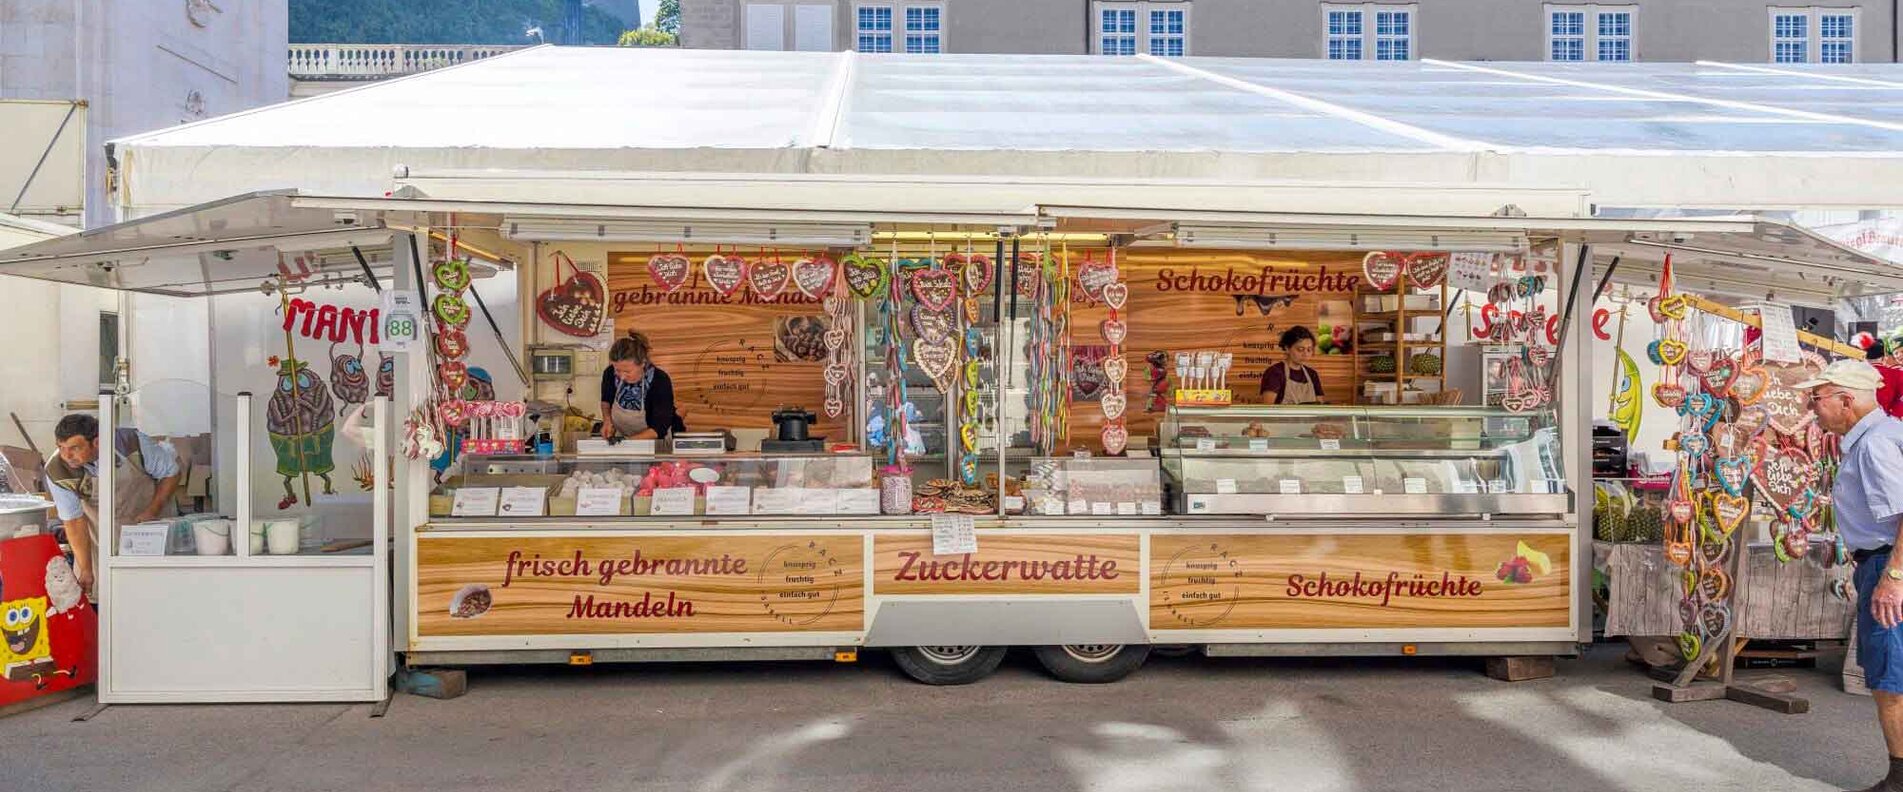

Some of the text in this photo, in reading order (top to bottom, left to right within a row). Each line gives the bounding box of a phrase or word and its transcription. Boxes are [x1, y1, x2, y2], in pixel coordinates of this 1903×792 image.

[1156, 266, 1360, 296] Schokofrüchte
[614, 284, 732, 313] gebrannte
[389, 320, 412, 336] 88
[1767, 401, 1799, 416] Dich
[502, 549, 748, 588] frisch gebrannte
[894, 551, 1120, 582] Zuckerwatte
[785, 575, 815, 584] fruchtig
[1187, 576, 1216, 585] fruchtig
[1286, 571, 1483, 607] Schokofrüchte
[566, 591, 696, 619] Mandeln
[779, 590, 820, 599] einfach gut
[1181, 591, 1221, 600] einfach gut
